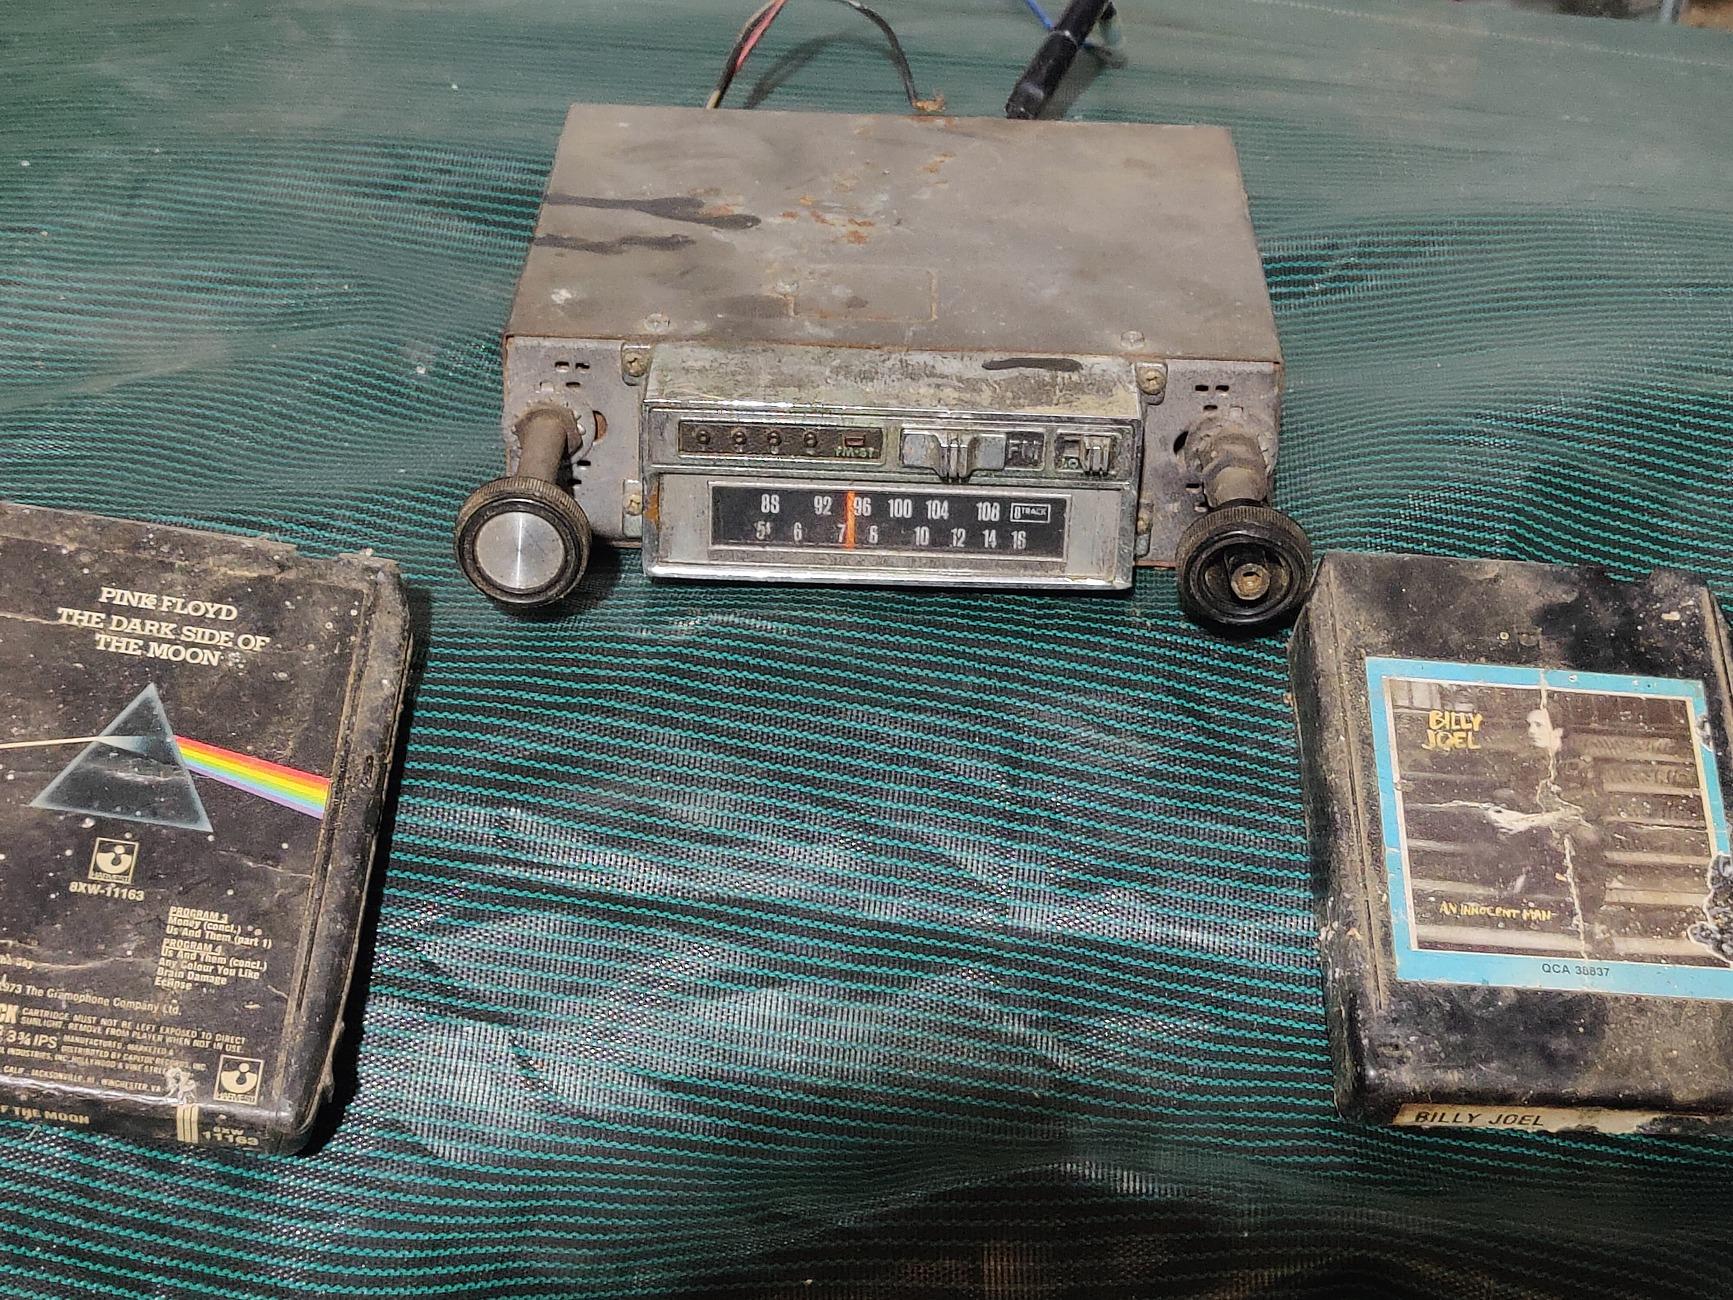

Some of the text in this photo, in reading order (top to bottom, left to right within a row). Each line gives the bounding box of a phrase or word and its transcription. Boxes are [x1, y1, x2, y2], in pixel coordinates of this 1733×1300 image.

[761, 494, 780, 513] 88
[814, 496, 832, 516] 92
[854, 497, 872, 516] 96
[888, 498, 912, 518] 100
[926, 500, 949, 520] 104
[976, 502, 1000, 522] 108
[794, 522, 802, 541] 6
[837, 524, 846, 542] 7
[914, 526, 930, 546] 10
[951, 528, 966, 547] 12
[982, 530, 997, 548] 14
[1011, 530, 1026, 550] 16
[99, 587, 238, 620] PINK FLOYD
[57, 607, 270, 651] THE DARK SIDE OF
[95, 633, 222, 666] THE MOON
[1428, 710, 1483, 732] BILLY
[1422, 730, 1482, 750] JOEL
[69, 882, 144, 901] 8XW-11163
[169, 906, 228, 922] PROGRAM 3
[1440, 901, 1552, 922] AN INNOCENT MAN
[168, 917, 242, 934] Money (concl.)
[163, 938, 222, 954] PROGRAM 4
[166, 925, 272, 949] Us And Them (part 1)
[159, 958, 260, 980] Any Colour You Like
[161, 948, 267, 972] Us And Them (concl.)
[1542, 963, 1571, 975] QCA
[156, 966, 227, 986] Brain Damage
[26, 985, 44, 996] The
[46, 989, 110, 1006] Gramophone
[113, 998, 158, 1013] Company
[162, 1003, 182, 1016] Ltd.
[22, 1008, 246, 1045] CARTRIDGE MUST NOT BE LEFT EXPOSED TO DIRECT
[68, 1023, 102, 1034] REMOVE
[106, 1028, 130, 1038] FROM
[132, 1032, 163, 1042] PLAYER
[166, 1036, 190, 1046] WHEN
[192, 1040, 210, 1049] NOT
[213, 1042, 224, 1050] IN
[32, 1034, 58, 1049] IPS
[110, 1051, 122, 1059] BY
[12, 1106, 41, 1118] THE
[44, 1110, 90, 1124] MOON
[1414, 1110, 1544, 1127] BILLY JOEL
